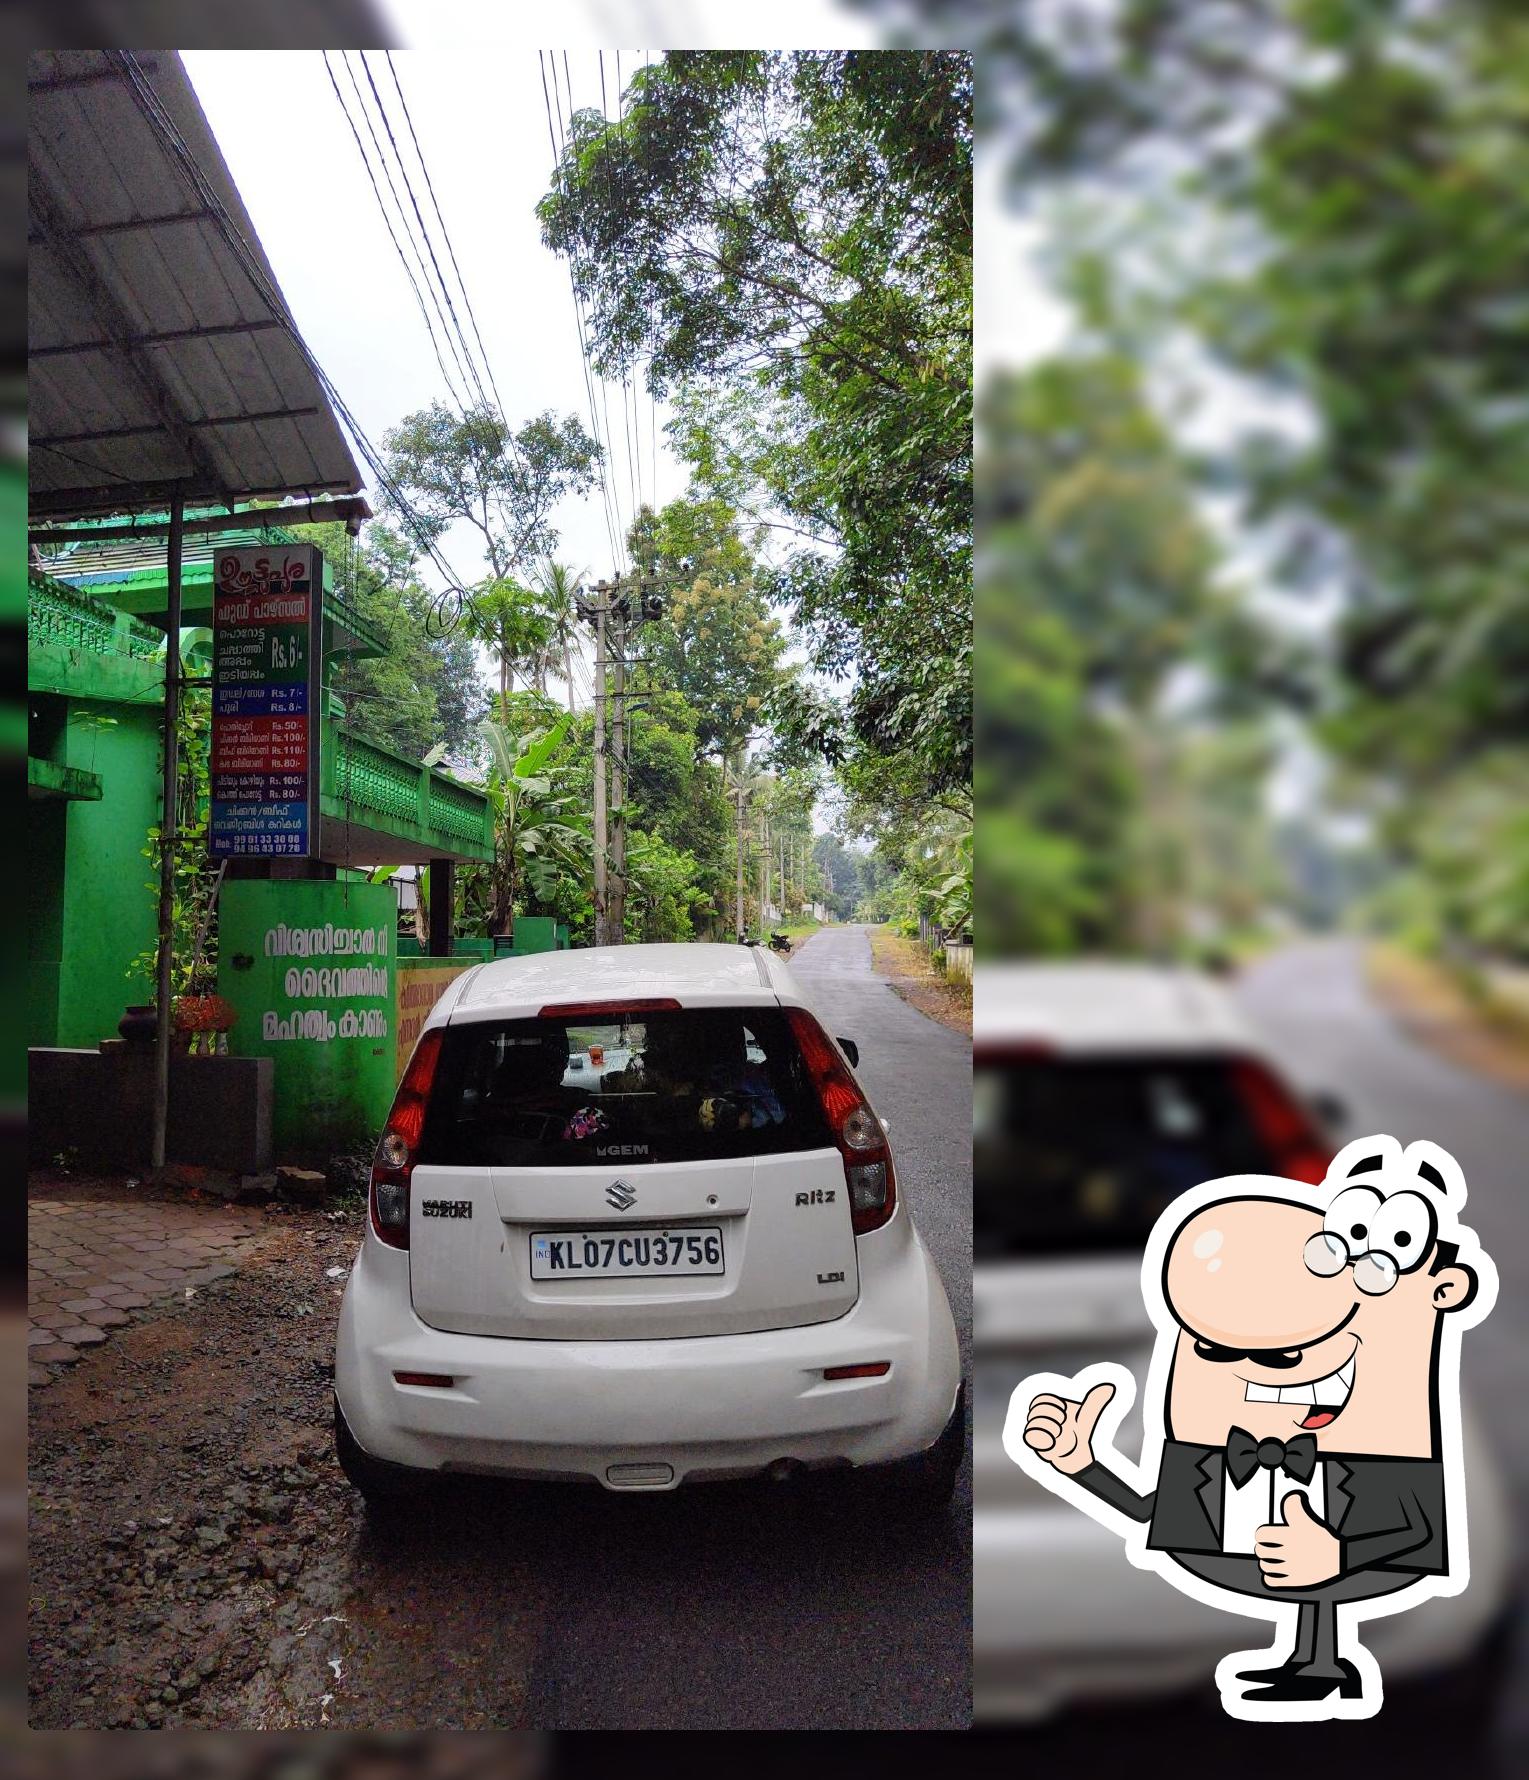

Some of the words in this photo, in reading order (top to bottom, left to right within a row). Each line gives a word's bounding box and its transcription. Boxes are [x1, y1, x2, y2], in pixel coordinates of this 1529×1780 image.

[271, 637, 288, 668] Rs.
[271, 689, 288, 698] Rs.
[270, 703, 287, 712] Rs.
[422, 1207, 473, 1219] SUZUKI
[550, 1236, 720, 1270] KL07CU3756
